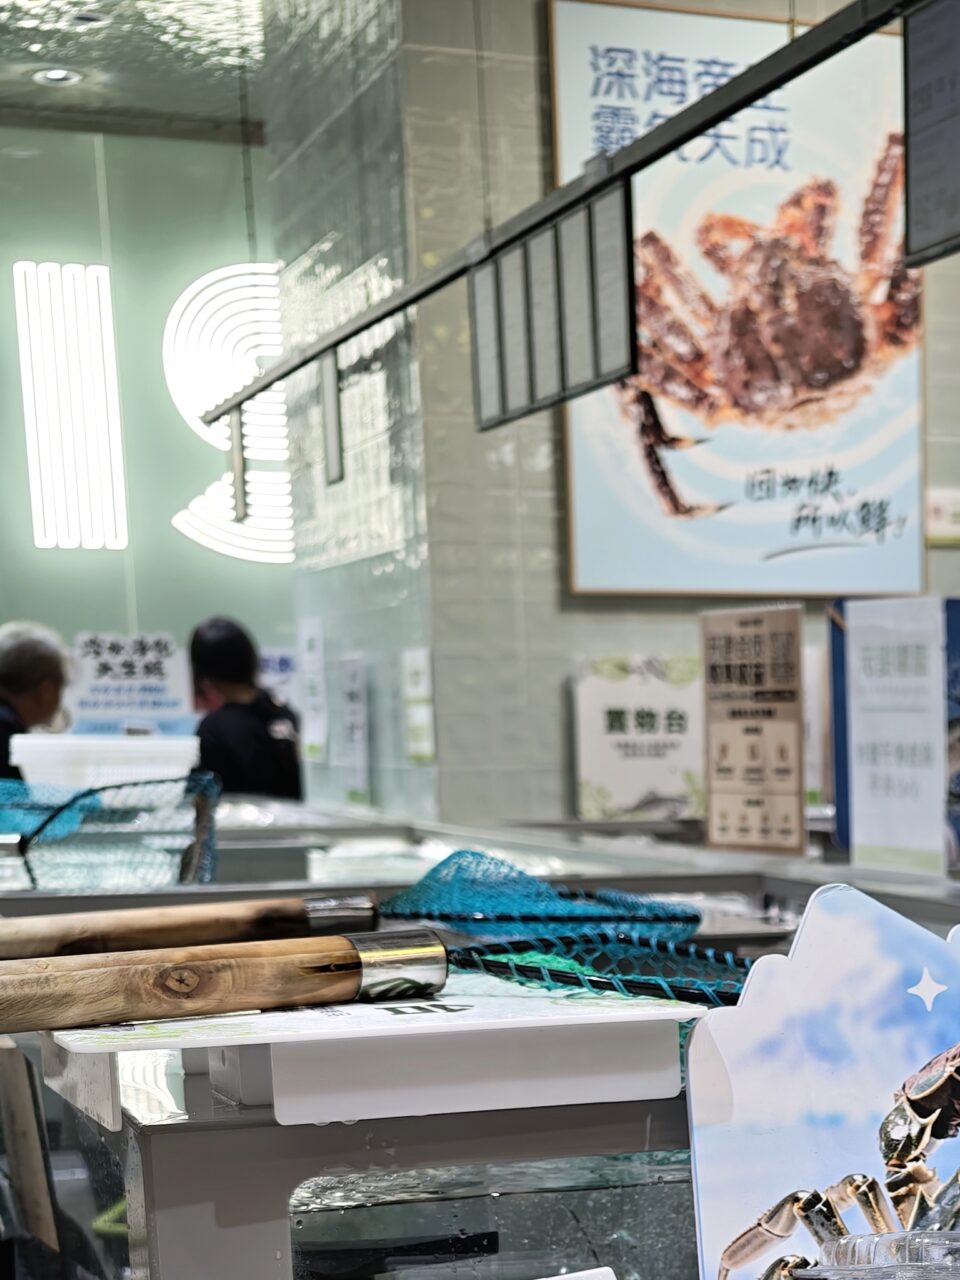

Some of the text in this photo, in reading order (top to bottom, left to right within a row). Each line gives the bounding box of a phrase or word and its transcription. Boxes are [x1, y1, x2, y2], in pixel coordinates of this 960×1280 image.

[589, 45, 787, 113] 深海帝
[604, 707, 690, 735] 置物台
